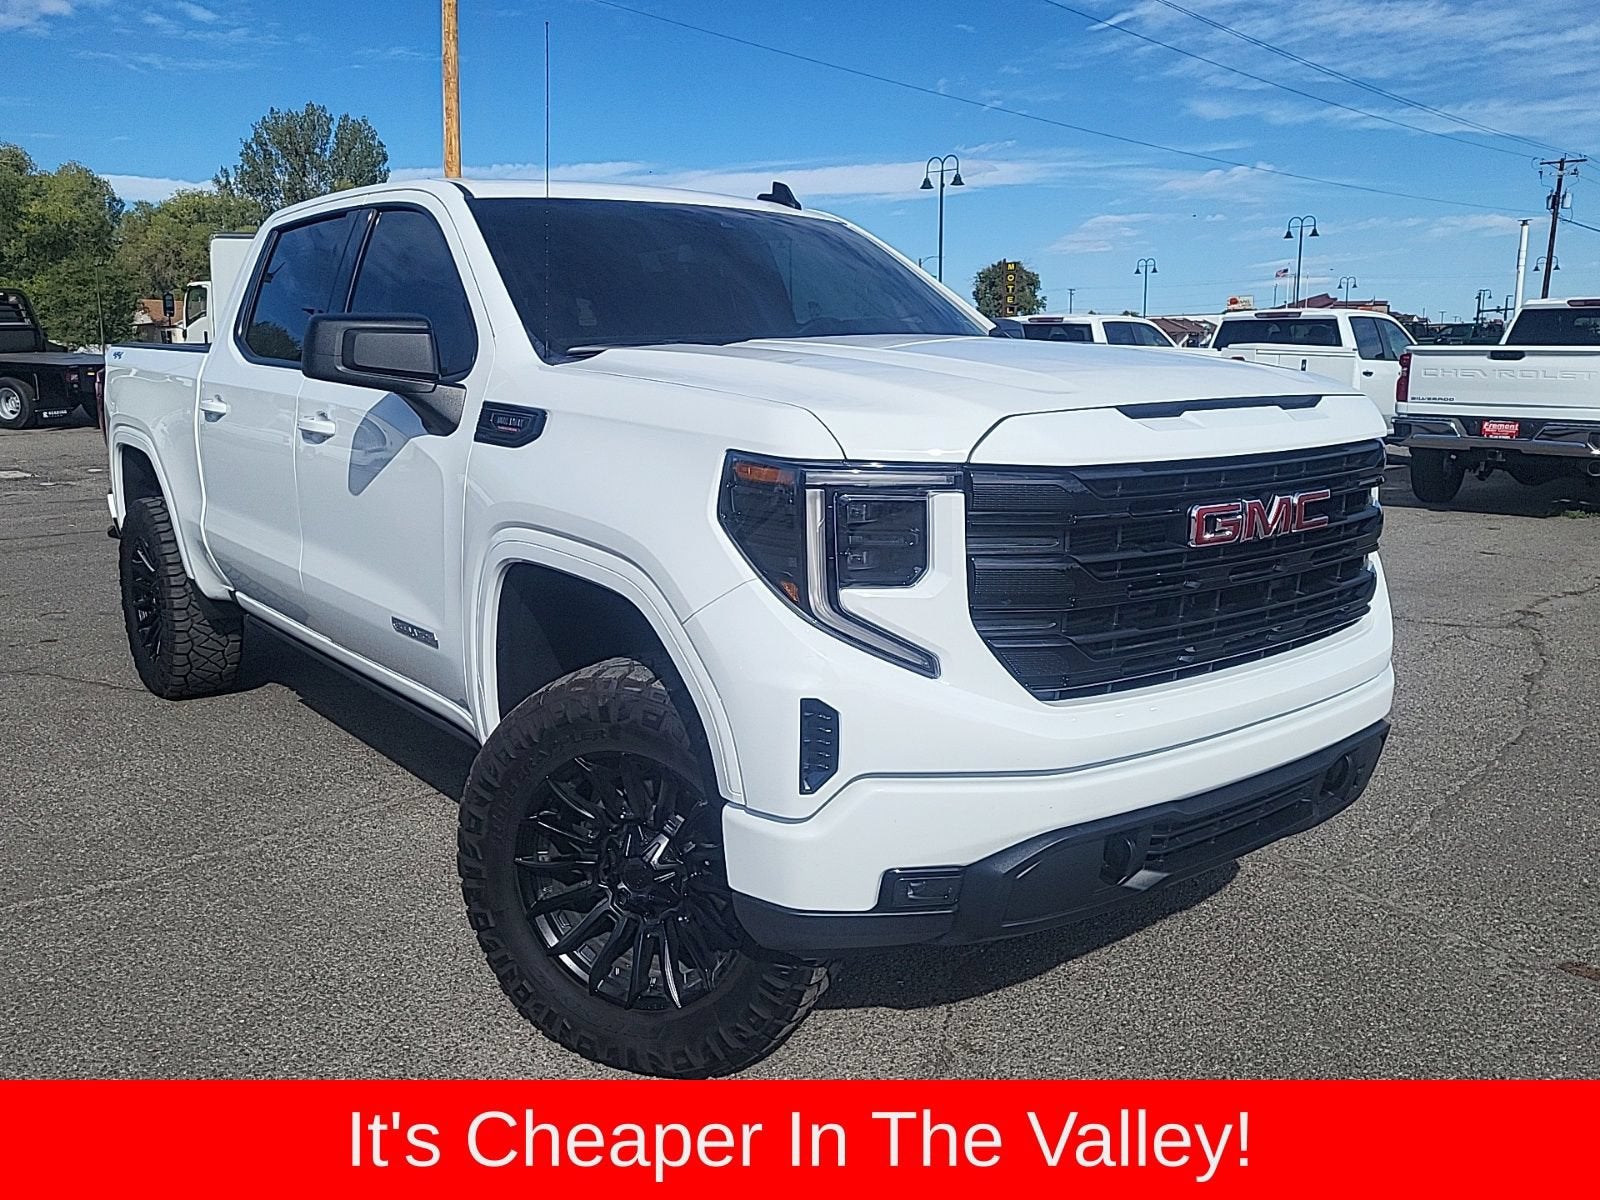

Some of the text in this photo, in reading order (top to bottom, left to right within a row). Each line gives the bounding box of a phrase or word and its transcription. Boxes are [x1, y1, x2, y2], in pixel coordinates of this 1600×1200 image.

[1006, 263, 1016, 314] MOTEL
[1421, 367, 1598, 381] CHEVROLET
[1188, 489, 1331, 547] GMC
